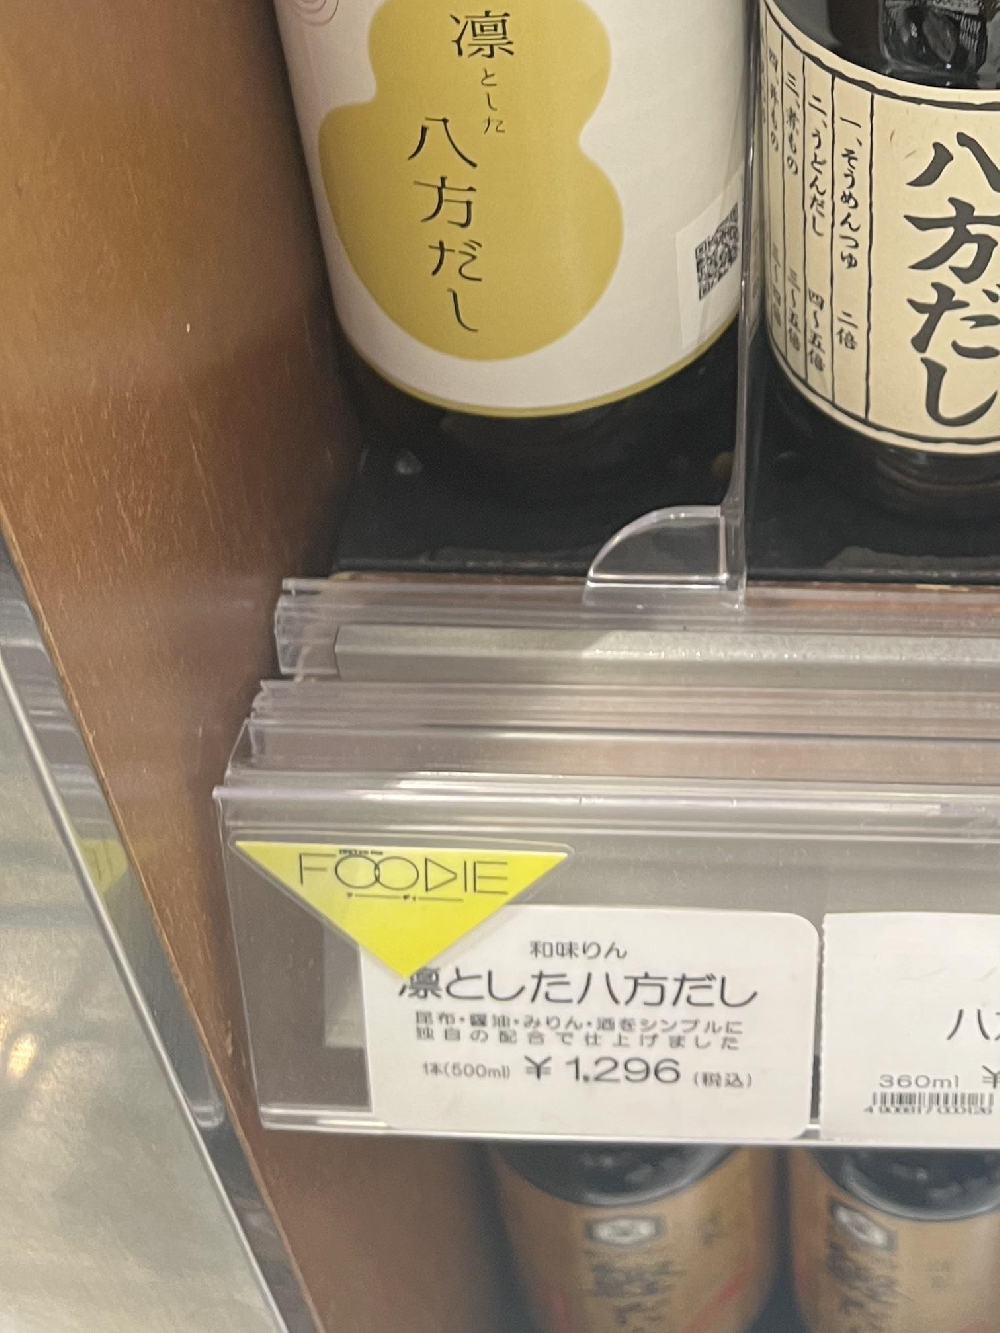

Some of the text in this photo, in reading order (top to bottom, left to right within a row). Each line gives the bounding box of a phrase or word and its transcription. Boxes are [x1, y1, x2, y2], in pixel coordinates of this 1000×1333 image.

[407, 117, 483, 333] 八方だし
[299, 852, 509, 895] FOODIE
[529, 940, 628, 960] 和味りん
[415, 1027, 740, 1051] 独自の配合で仕上げました
[523, 1054, 553, 1080] ¥
[692, 1071, 753, 1088] (税込)
[879, 1074, 960, 1088] 360ml
